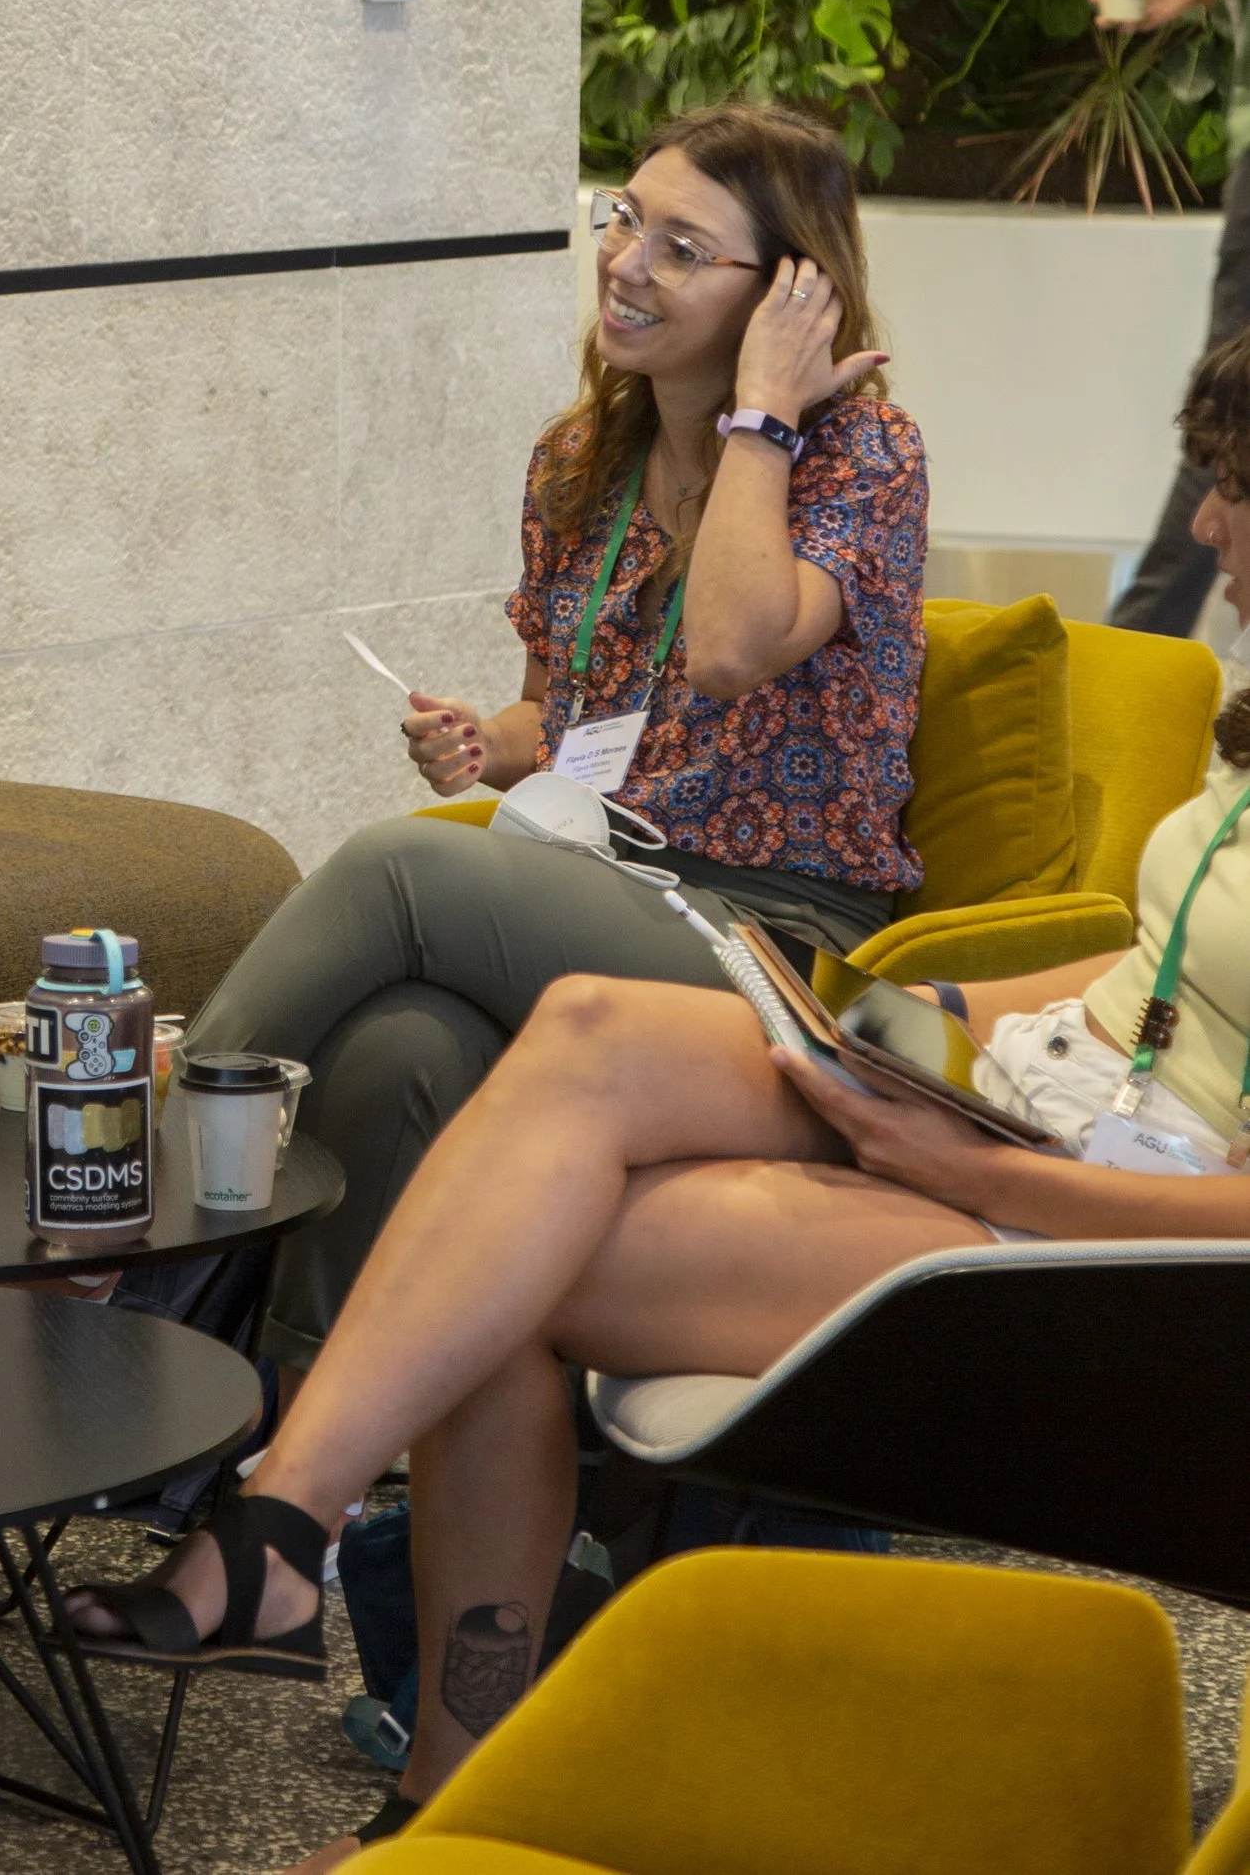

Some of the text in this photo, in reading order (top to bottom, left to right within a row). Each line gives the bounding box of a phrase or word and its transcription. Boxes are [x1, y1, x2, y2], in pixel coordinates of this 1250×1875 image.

[1133, 1132, 1169, 1155] AGU
[49, 1160, 143, 1191] CSDMS
[91, 1191, 120, 1202] surface
[49, 1202, 84, 1213] dynamics
[85, 1201, 120, 1211] modeling
